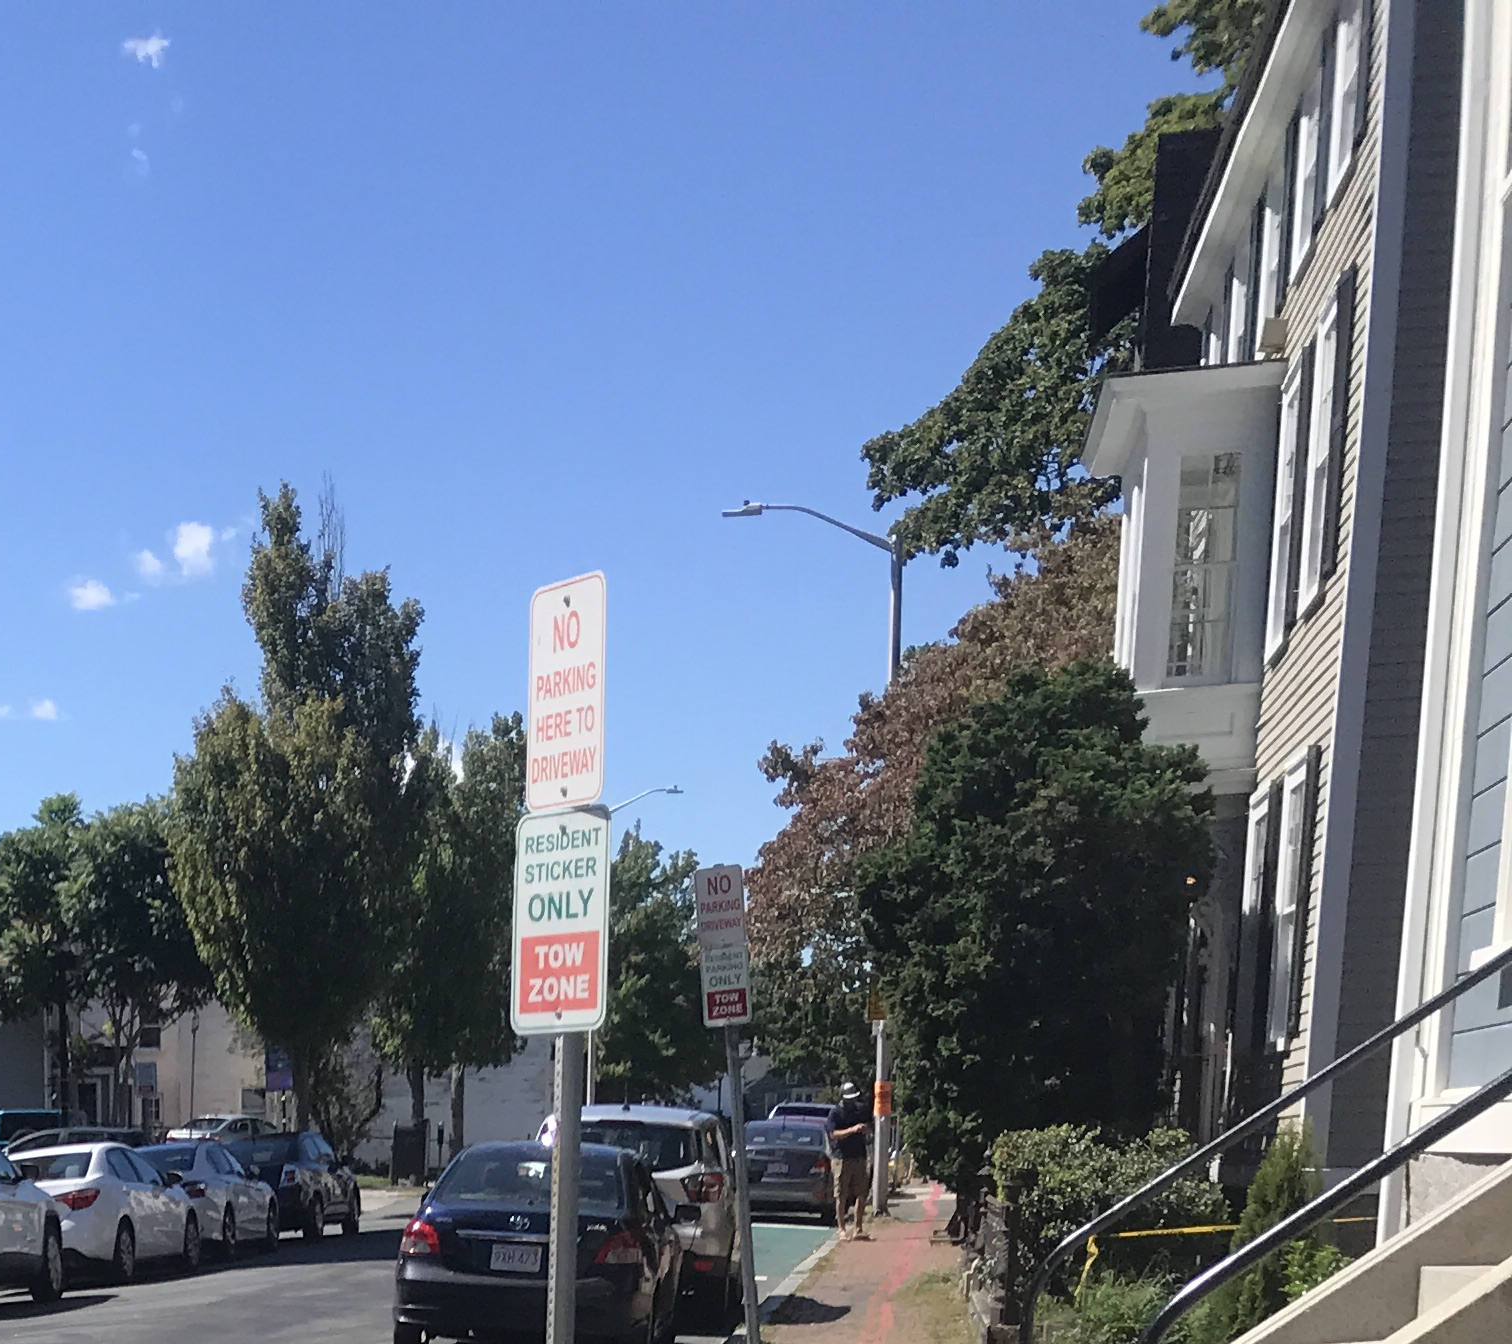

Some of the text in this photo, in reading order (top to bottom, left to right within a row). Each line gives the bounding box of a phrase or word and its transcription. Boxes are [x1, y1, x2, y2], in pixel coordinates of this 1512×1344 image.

[552, 609, 581, 654] NO
[536, 661, 597, 702] PARKING
[536, 704, 595, 744] HERE TO
[531, 744, 597, 785] DRIVEWAY
[525, 827, 602, 855] RESIDENT
[524, 856, 597, 884] STICKER
[707, 874, 732, 896] NO
[528, 887, 595, 922] ONLY
[700, 898, 741, 914] PARKING
[534, 941, 585, 970] TOW
[528, 973, 590, 1004] ZONE
[709, 973, 741, 987] ONLY
[712, 1003, 743, 1017] ZONE
[714, 991, 739, 1004] TOW
